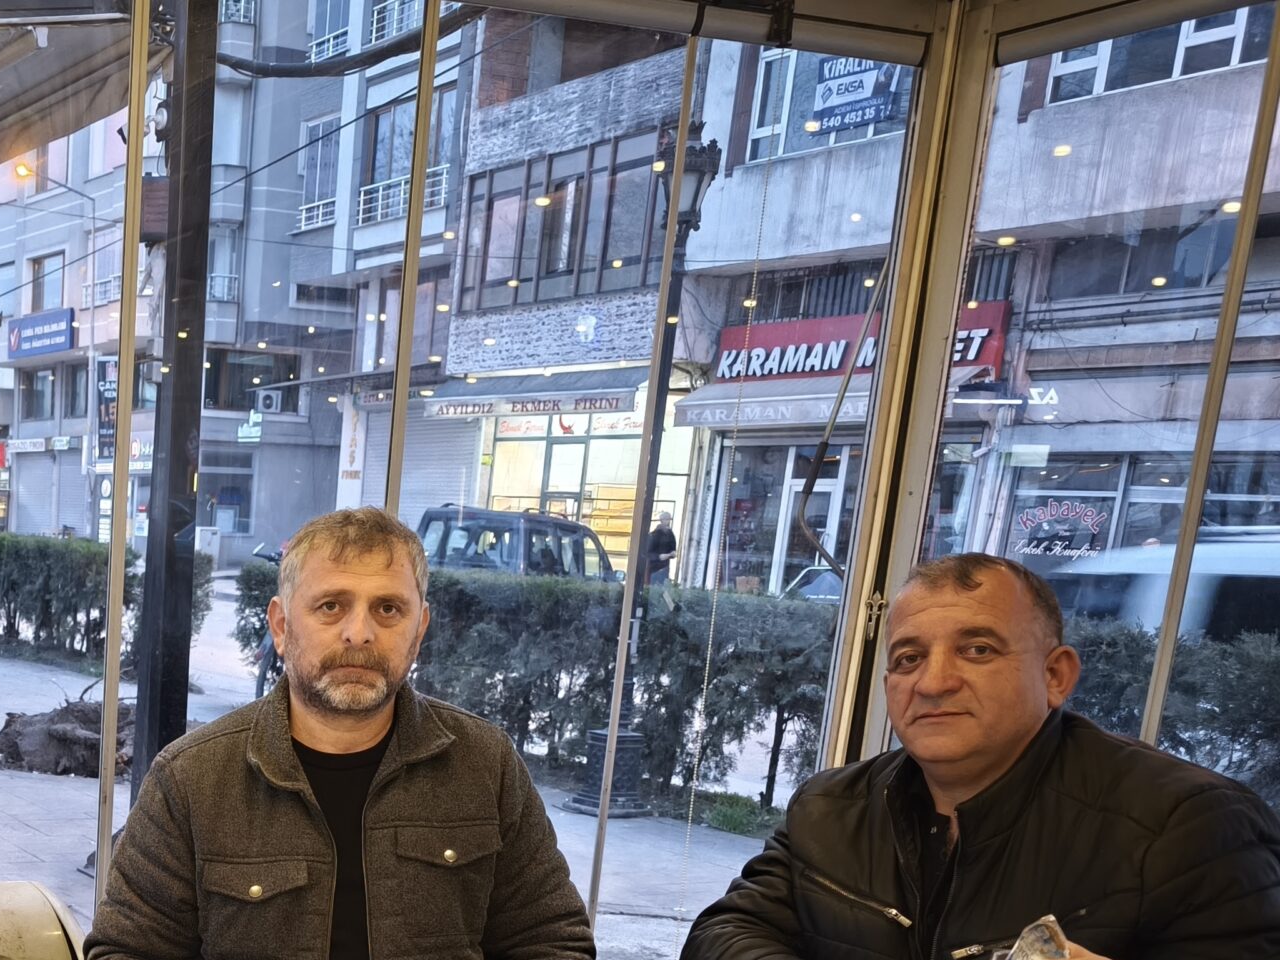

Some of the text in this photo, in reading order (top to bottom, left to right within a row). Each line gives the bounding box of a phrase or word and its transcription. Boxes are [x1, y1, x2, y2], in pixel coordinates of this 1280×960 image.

[716, 339, 847, 379] KARAMAN
[436, 402, 495, 416] AYYILDIZ
[511, 399, 562, 413] EKMEK
[686, 405, 794, 423] KARAMAN
[1014, 539, 1045, 555] Erkek
